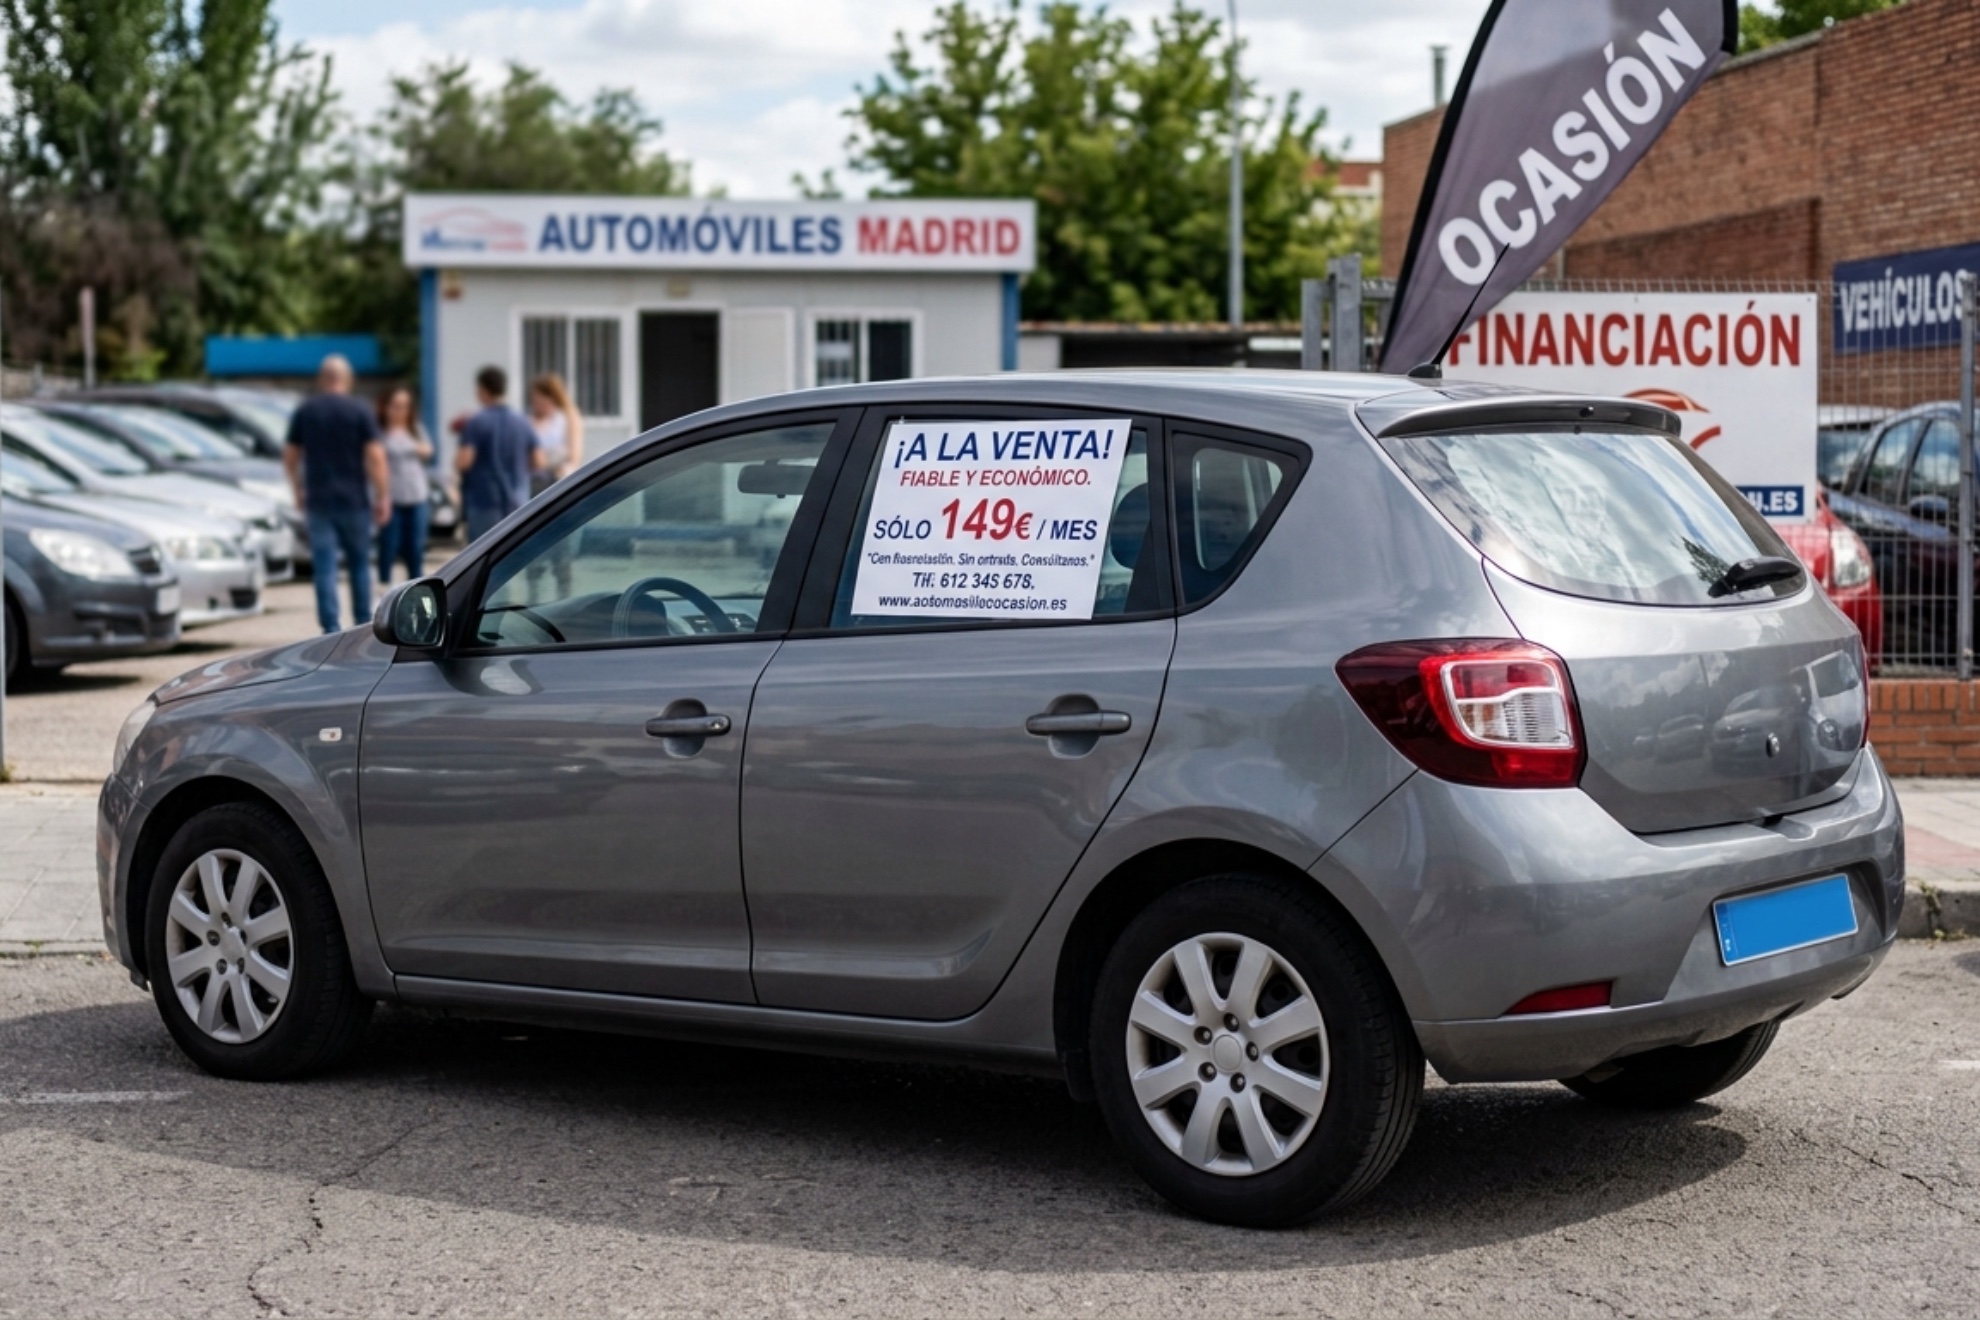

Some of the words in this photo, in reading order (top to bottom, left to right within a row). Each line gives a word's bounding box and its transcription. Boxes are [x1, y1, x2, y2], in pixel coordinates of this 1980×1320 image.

[1437, 7, 1706, 286] OCASIÓN
[538, 204, 843, 254] AUTOMÓVILES
[858, 216, 1021, 256] MADRID
[893, 432, 927, 468] ¡A
[936, 431, 979, 461] LA
[992, 429, 1114, 460] VENTA!
[900, 470, 960, 487] FIABLE
[966, 470, 978, 487] Y
[979, 466, 1092, 486] ECONÓMICO.
[873, 515, 932, 540] SÓLO
[941, 498, 1033, 541] 149€
[1050, 519, 1098, 541] MES
[958, 553, 975, 566] Sin
[939, 572, 968, 589] 612
